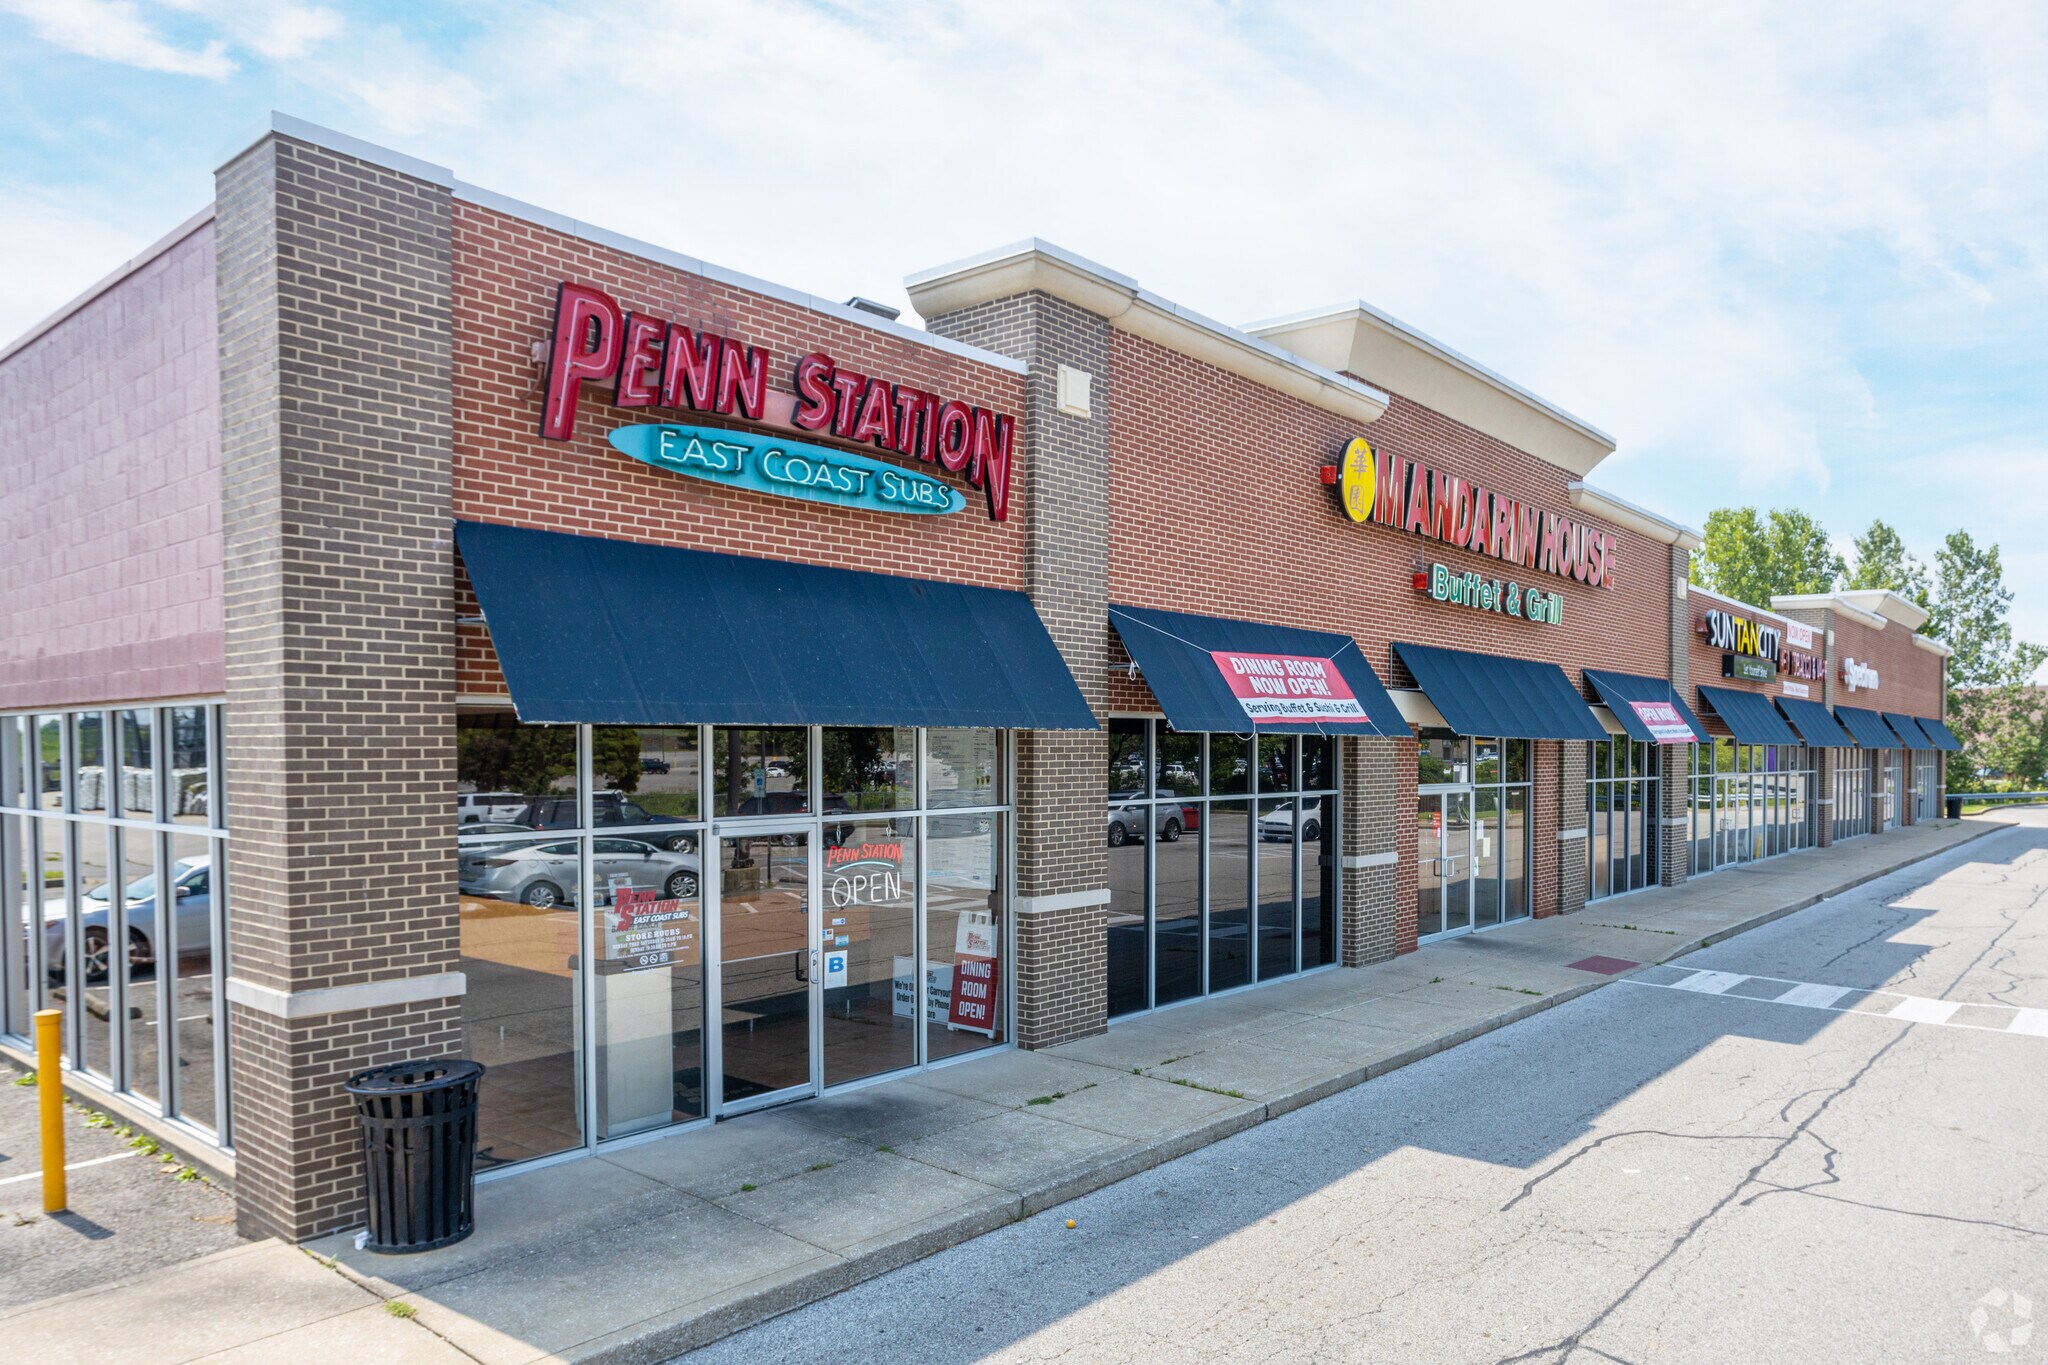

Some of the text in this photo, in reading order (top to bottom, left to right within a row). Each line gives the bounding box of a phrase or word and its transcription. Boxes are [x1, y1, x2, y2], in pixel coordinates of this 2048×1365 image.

[540, 281, 1014, 521] PENN STATION
[657, 429, 950, 509] EAST COAST SUBS
[1374, 449, 1616, 590] MANDARIN HOUSE
[1432, 563, 1564, 625] Buffet & Grill
[1229, 657, 1327, 679] DINING ROOM
[1248, 676, 1332, 697] NOW OPEN!
[1245, 702, 1359, 714] Serving Buffet & Sushi & Grill
[826, 845, 860, 869] PENN
[861, 842, 903, 864] STATION
[832, 871, 900, 907] OPEN
[614, 887, 657, 914] PENN
[617, 899, 680, 932] STATION
[633, 911, 689, 925] EAST COAST SUBS
[625, 928, 680, 942] STORE HOURS
[829, 956, 844, 973] B
[961, 960, 991, 979] DINING
[930, 986, 951, 998] Carryou
[961, 980, 987, 999] ROOM
[958, 1001, 986, 1020] OPEN!
